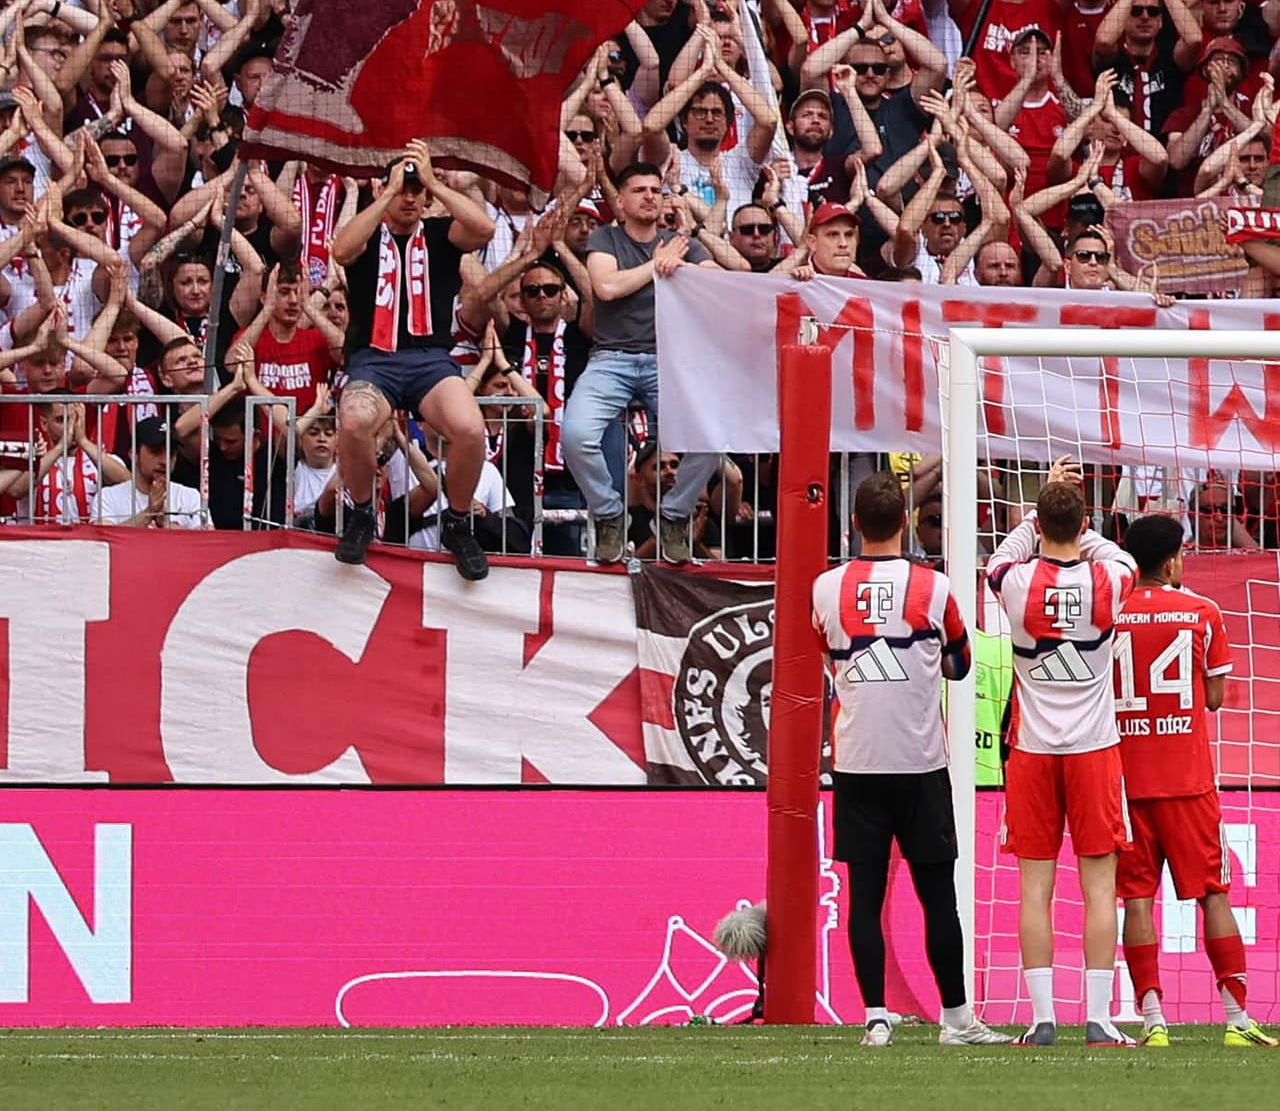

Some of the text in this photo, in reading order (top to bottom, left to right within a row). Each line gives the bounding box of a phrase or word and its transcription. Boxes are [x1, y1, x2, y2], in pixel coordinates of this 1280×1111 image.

[702, 610, 775, 660] UL
[1113, 628, 1193, 711] 14
[1117, 714, 1193, 737] LUIS DÍAZ
